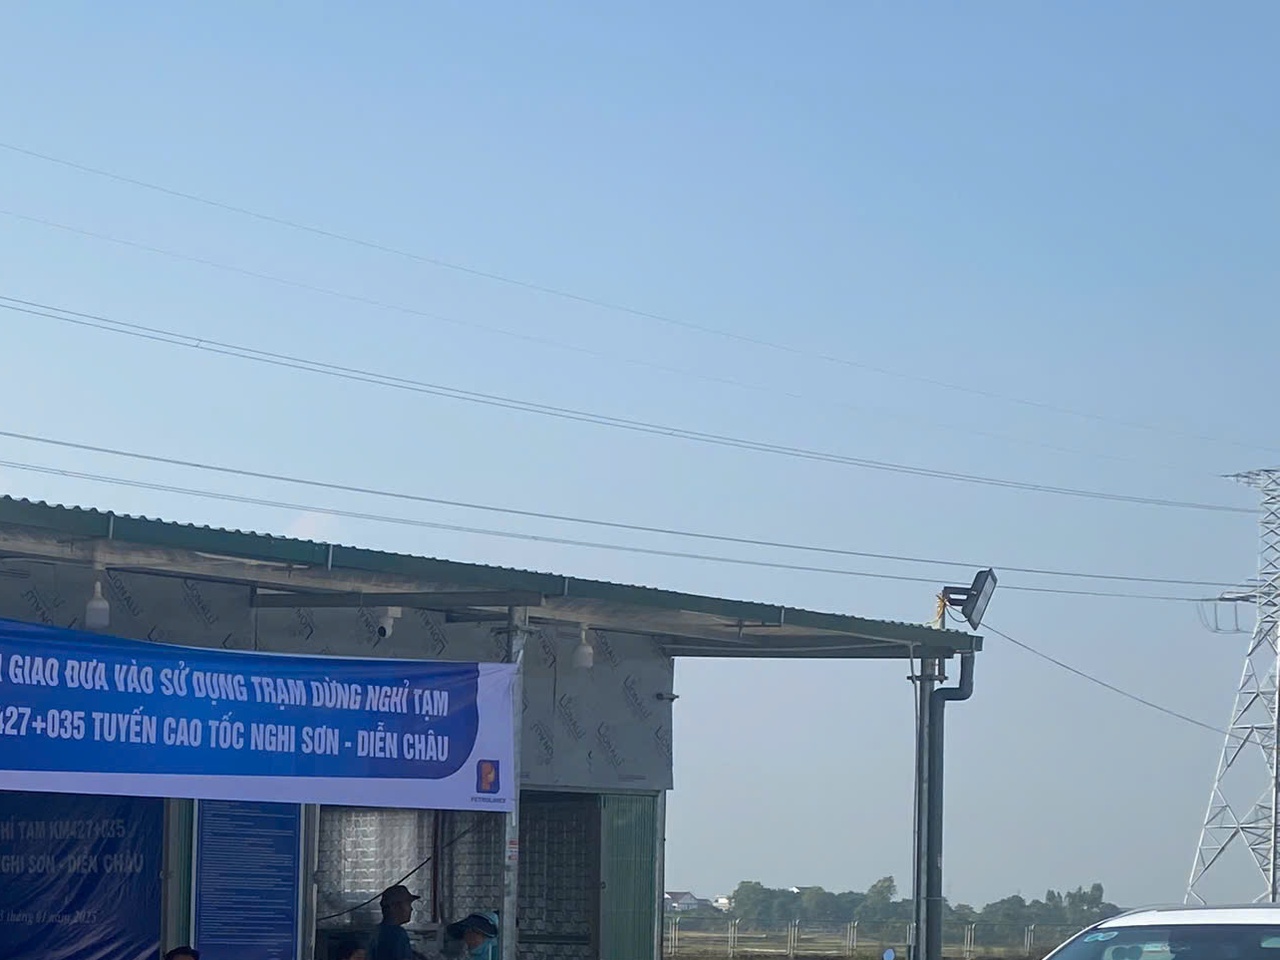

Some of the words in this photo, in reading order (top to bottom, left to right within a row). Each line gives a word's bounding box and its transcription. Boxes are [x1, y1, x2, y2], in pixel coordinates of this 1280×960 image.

[9, 654, 59, 687] GIAO
[65, 659, 109, 691] ĐƯA
[114, 659, 154, 694] VÀO
[160, 661, 190, 697] SỬ
[192, 671, 248, 705] DỤNG
[251, 676, 306, 710] TRẠM
[310, 677, 362, 710] DỪNG
[365, 679, 410, 714] NGHỈ
[413, 688, 449, 721] TẠM
[92, 706, 157, 744] TUYẾN
[163, 717, 202, 747] CAO
[208, 711, 244, 749] TỐC
[250, 723, 296, 752] NGHI
[301, 725, 339, 755] SƠN
[357, 722, 398, 759] DIỄN
[403, 729, 449, 762] CHÂU
